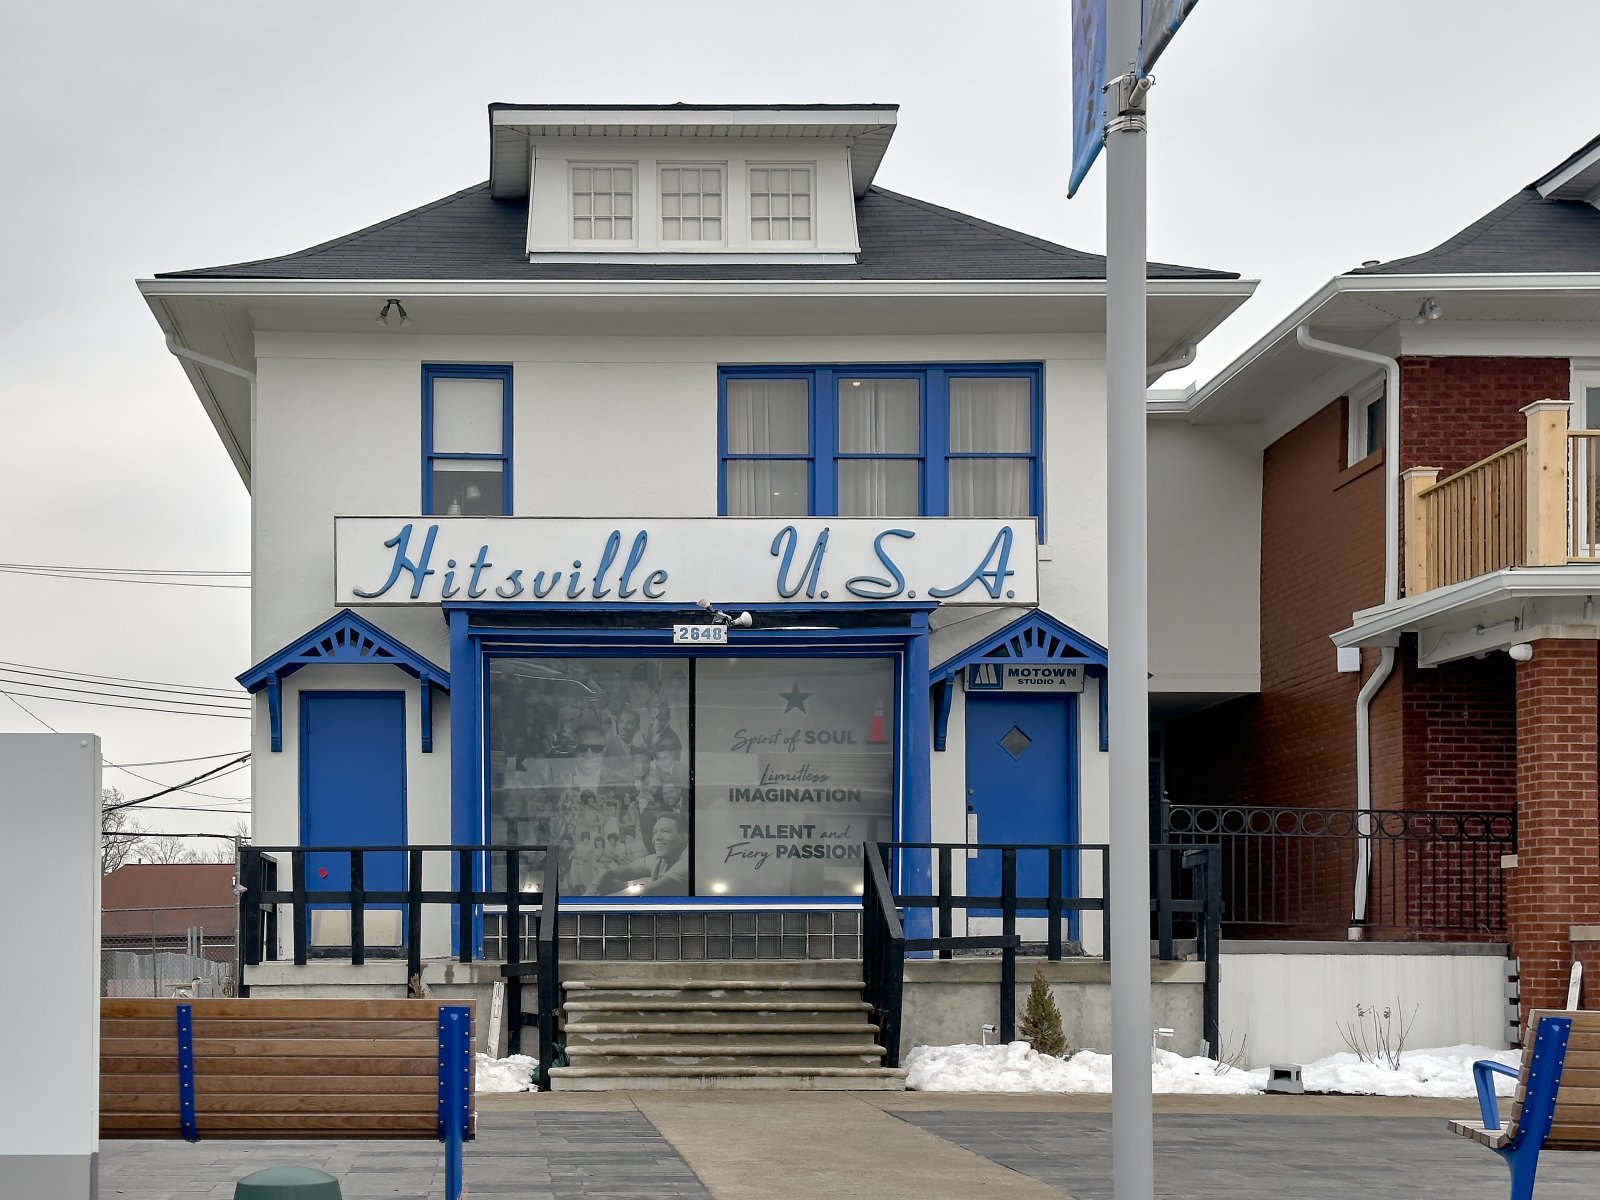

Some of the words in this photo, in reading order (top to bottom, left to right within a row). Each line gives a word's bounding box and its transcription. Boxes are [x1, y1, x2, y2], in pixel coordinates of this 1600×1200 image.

[353, 523, 668, 599] Hitsville
[771, 525, 1015, 599] U.S.A.
[679, 626, 722, 641] 2648
[1008, 668, 1077, 678] MOTOWN
[730, 728, 783, 754] Spirit
[784, 729, 801, 754] of
[804, 730, 857, 745] SOUL
[759, 763, 831, 786] Limitless
[729, 788, 861, 803] IMAGINATION
[739, 824, 816, 839] TALENT
[820, 825, 851, 839] and
[724, 842, 772, 870] Fiery
[776, 844, 861, 859] PASSION
